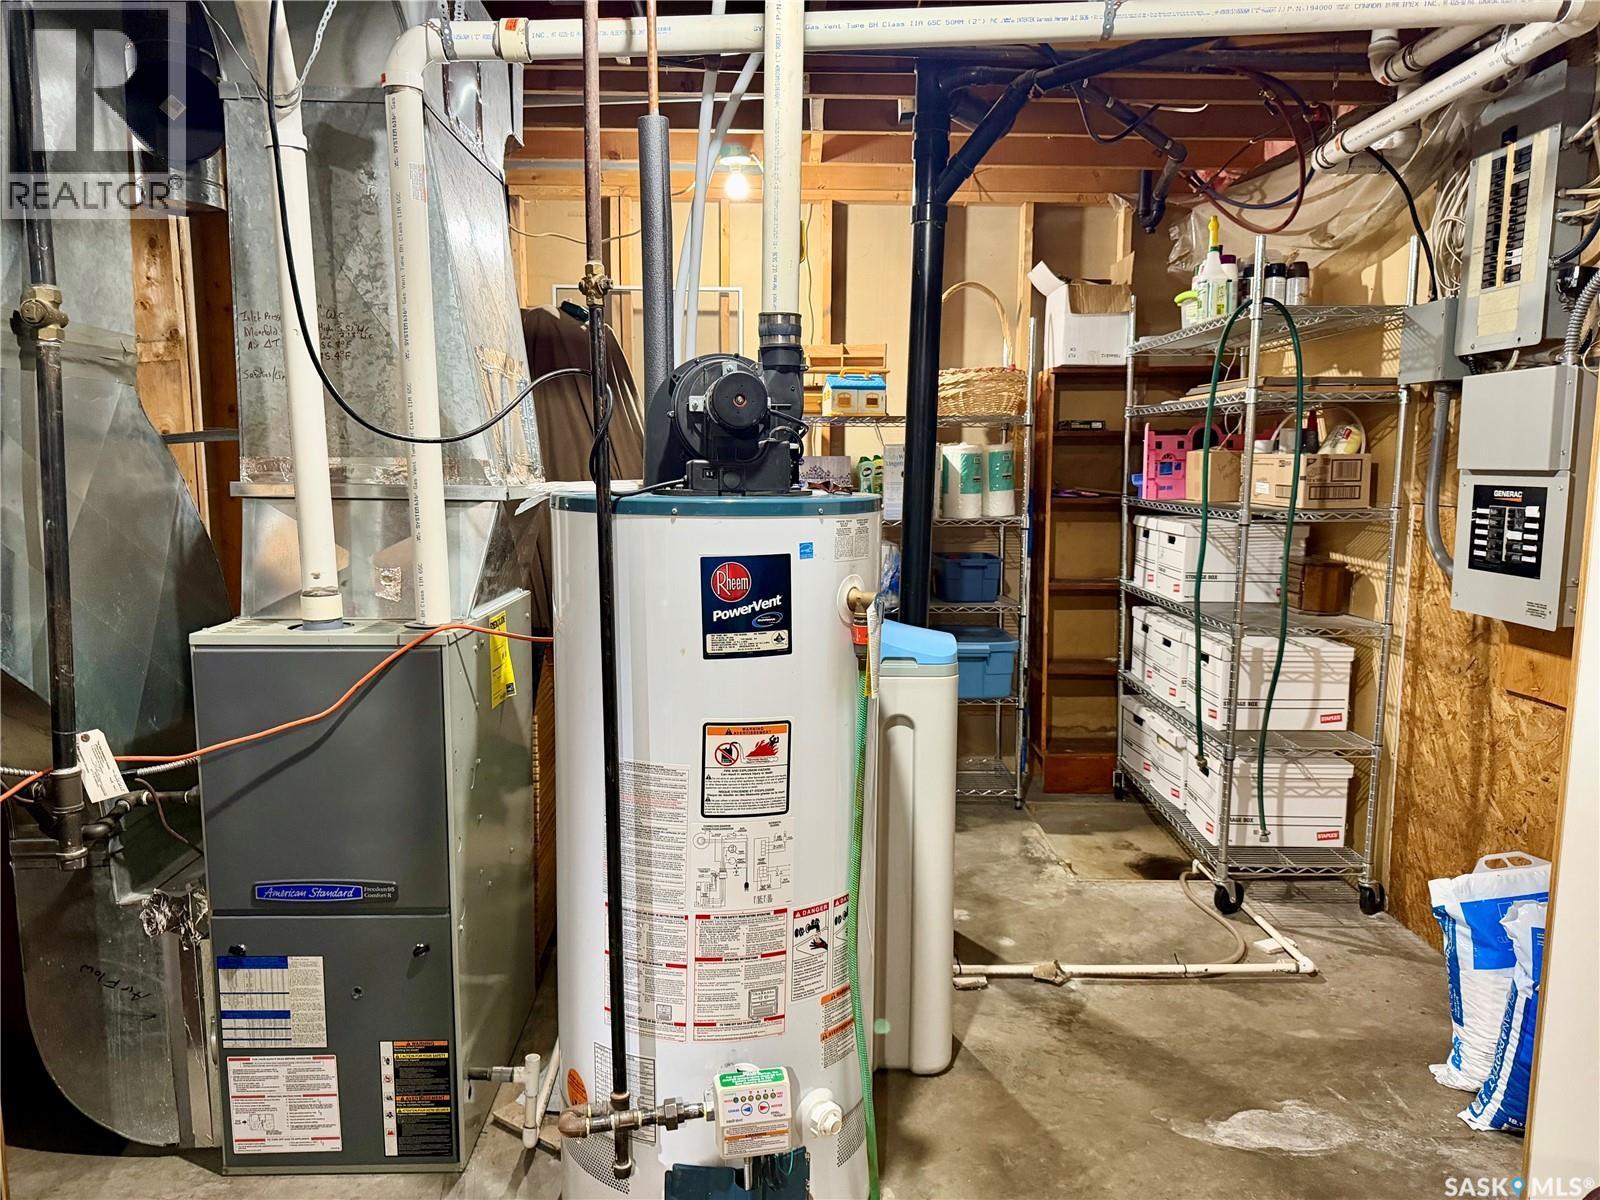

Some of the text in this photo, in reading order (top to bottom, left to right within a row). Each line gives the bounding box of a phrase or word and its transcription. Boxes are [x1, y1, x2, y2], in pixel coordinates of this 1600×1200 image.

[1493, 489, 1524, 498] GENERAC
[715, 564, 749, 596] Rheem
[712, 594, 783, 623] PowerVent
[263, 886, 355, 899] American Standard
[802, 904, 828, 916] DANGER
[80, 964, 121, 989] Flow
[1502, 990, 1517, 1031] CLEAN
